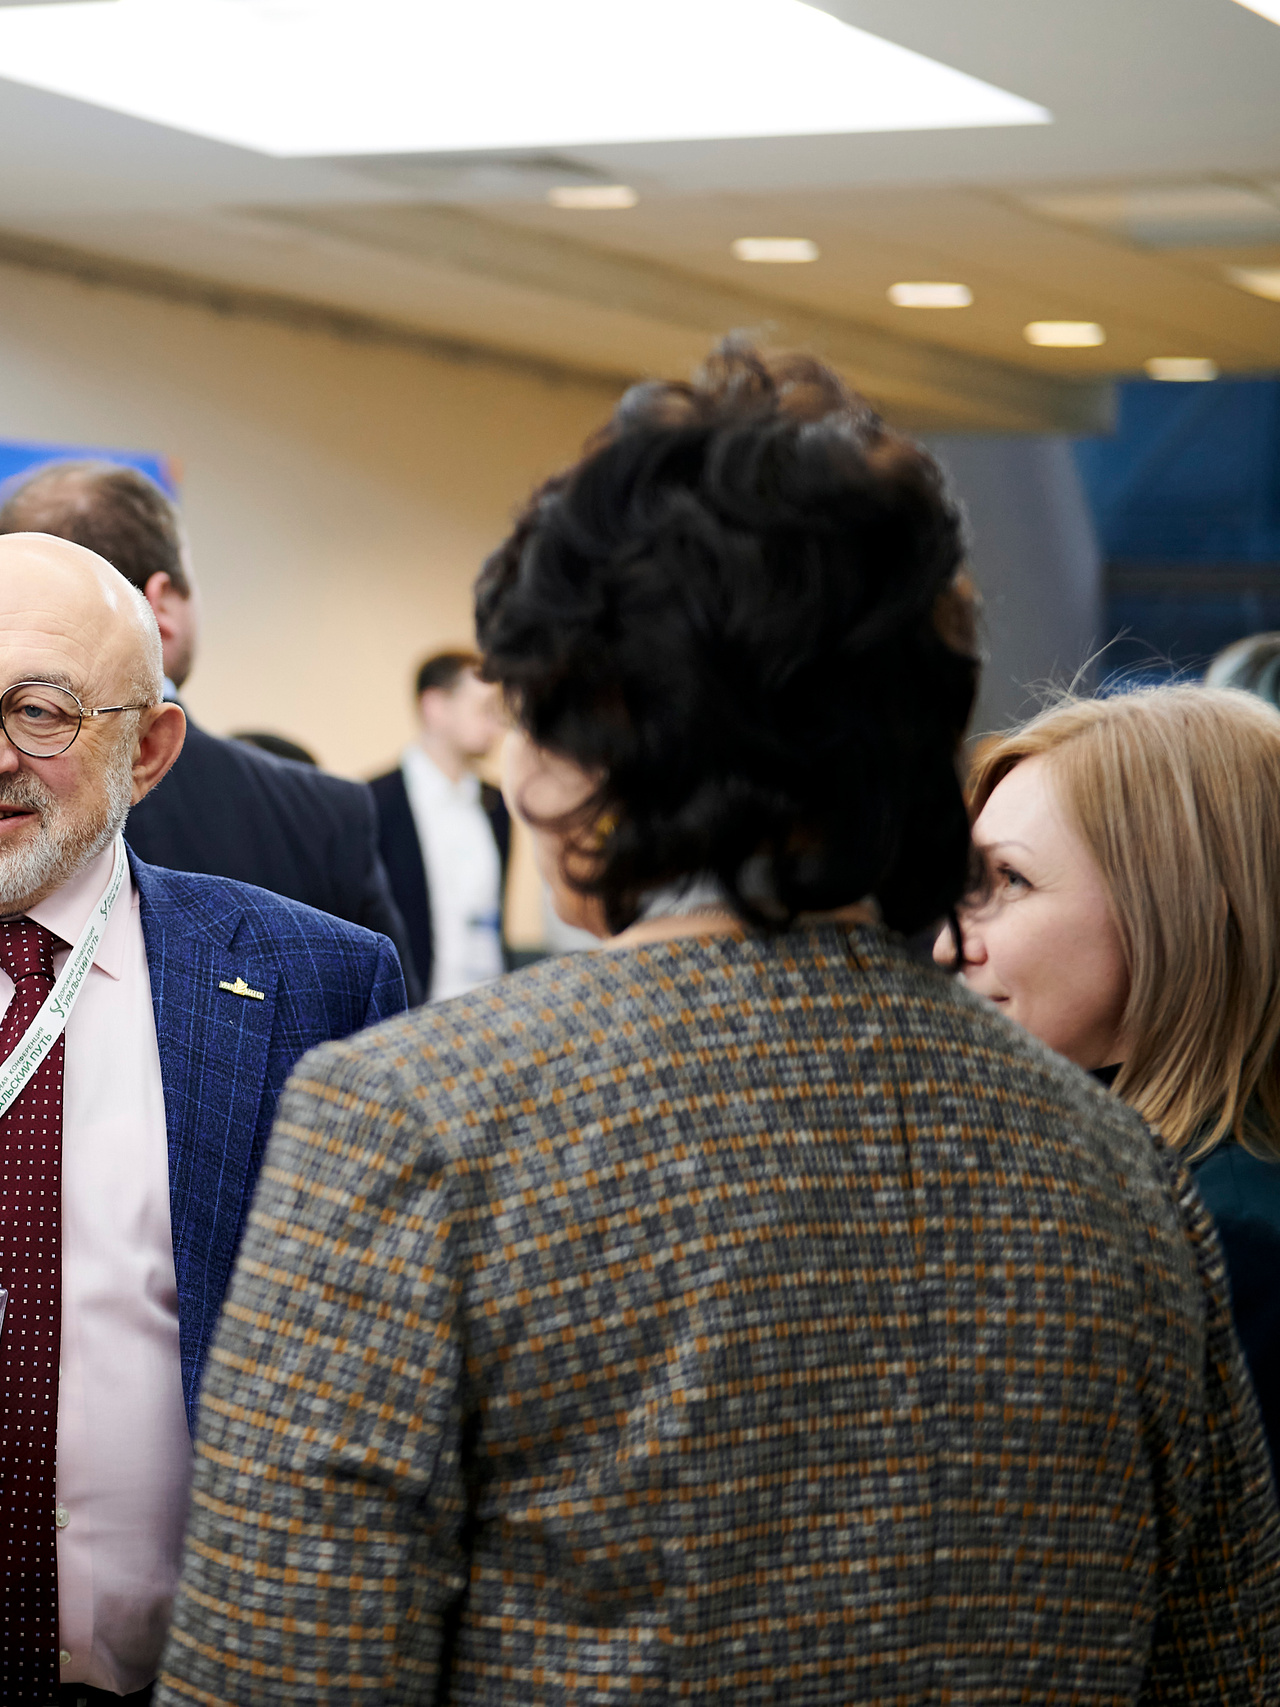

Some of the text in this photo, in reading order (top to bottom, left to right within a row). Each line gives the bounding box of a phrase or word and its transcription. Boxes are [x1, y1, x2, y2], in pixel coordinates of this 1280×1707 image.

[63, 934, 99, 1008] УРАЛЬСКИЙ ПУТЬ
[8, 1026, 45, 1075] КОНФЕРЕНЦИЯ
[29, 1033, 53, 1062] ПУТЬ
